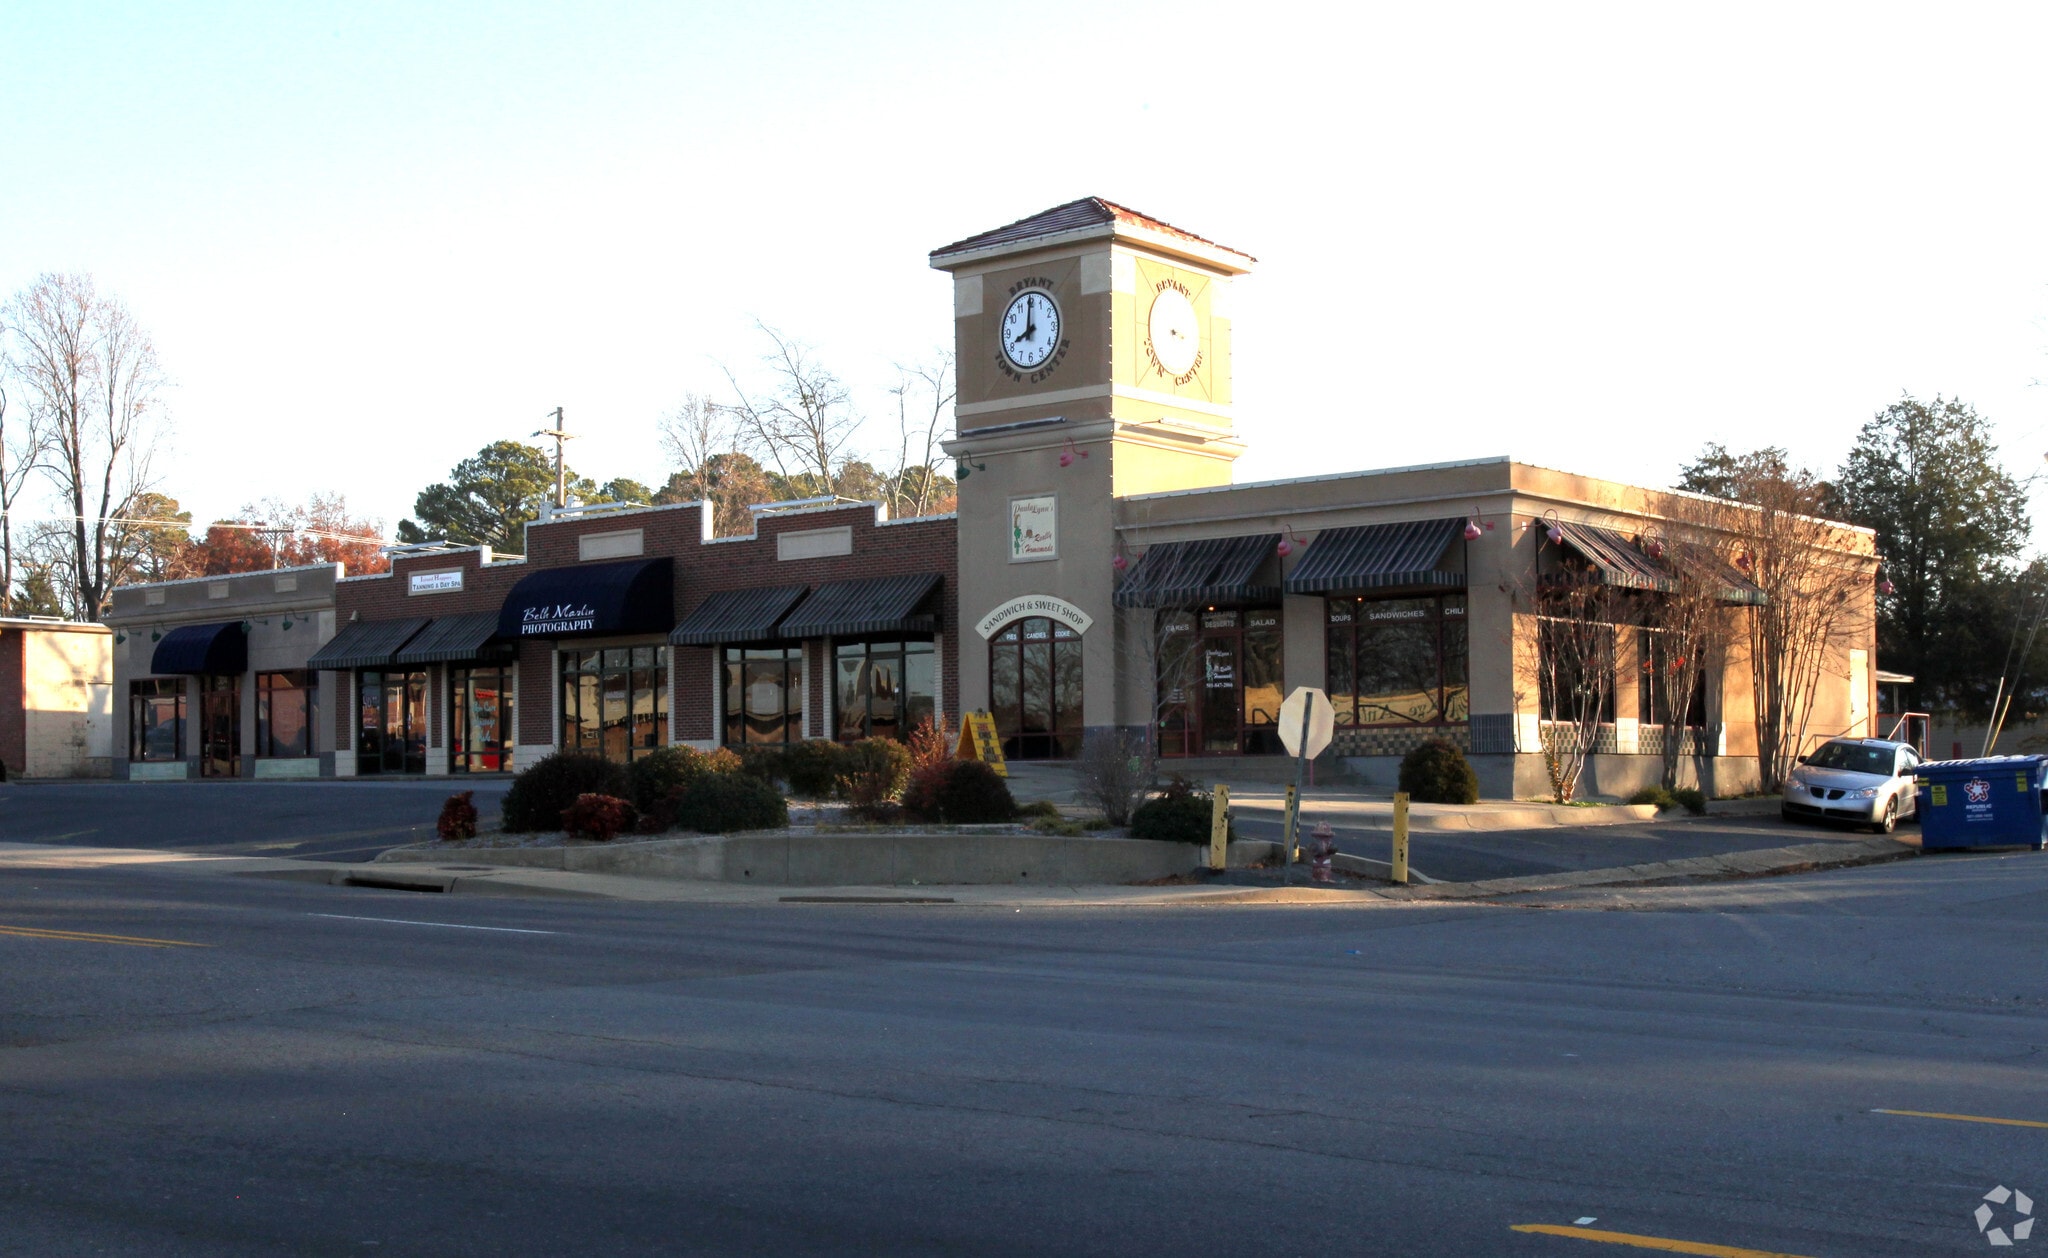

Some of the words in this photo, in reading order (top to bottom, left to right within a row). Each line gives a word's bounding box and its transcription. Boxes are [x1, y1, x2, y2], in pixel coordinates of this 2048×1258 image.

[1008, 277, 1054, 297] BRYANT
[995, 349, 1022, 383] TOWN
[1030, 338, 1070, 384] CENTER
[983, 602, 1026, 632] SANDWICH
[1026, 600, 1033, 610] &
[1034, 600, 1062, 613] SWEET
[1062, 607, 1085, 625] SHOP
[1250, 618, 1276, 627] SALAD
[1330, 614, 1352, 622] SOUPS
[1369, 609, 1425, 620] SANDWICHES
[1444, 607, 1464, 615] CHILI
[521, 619, 595, 635] PHOTOGRAPHY
